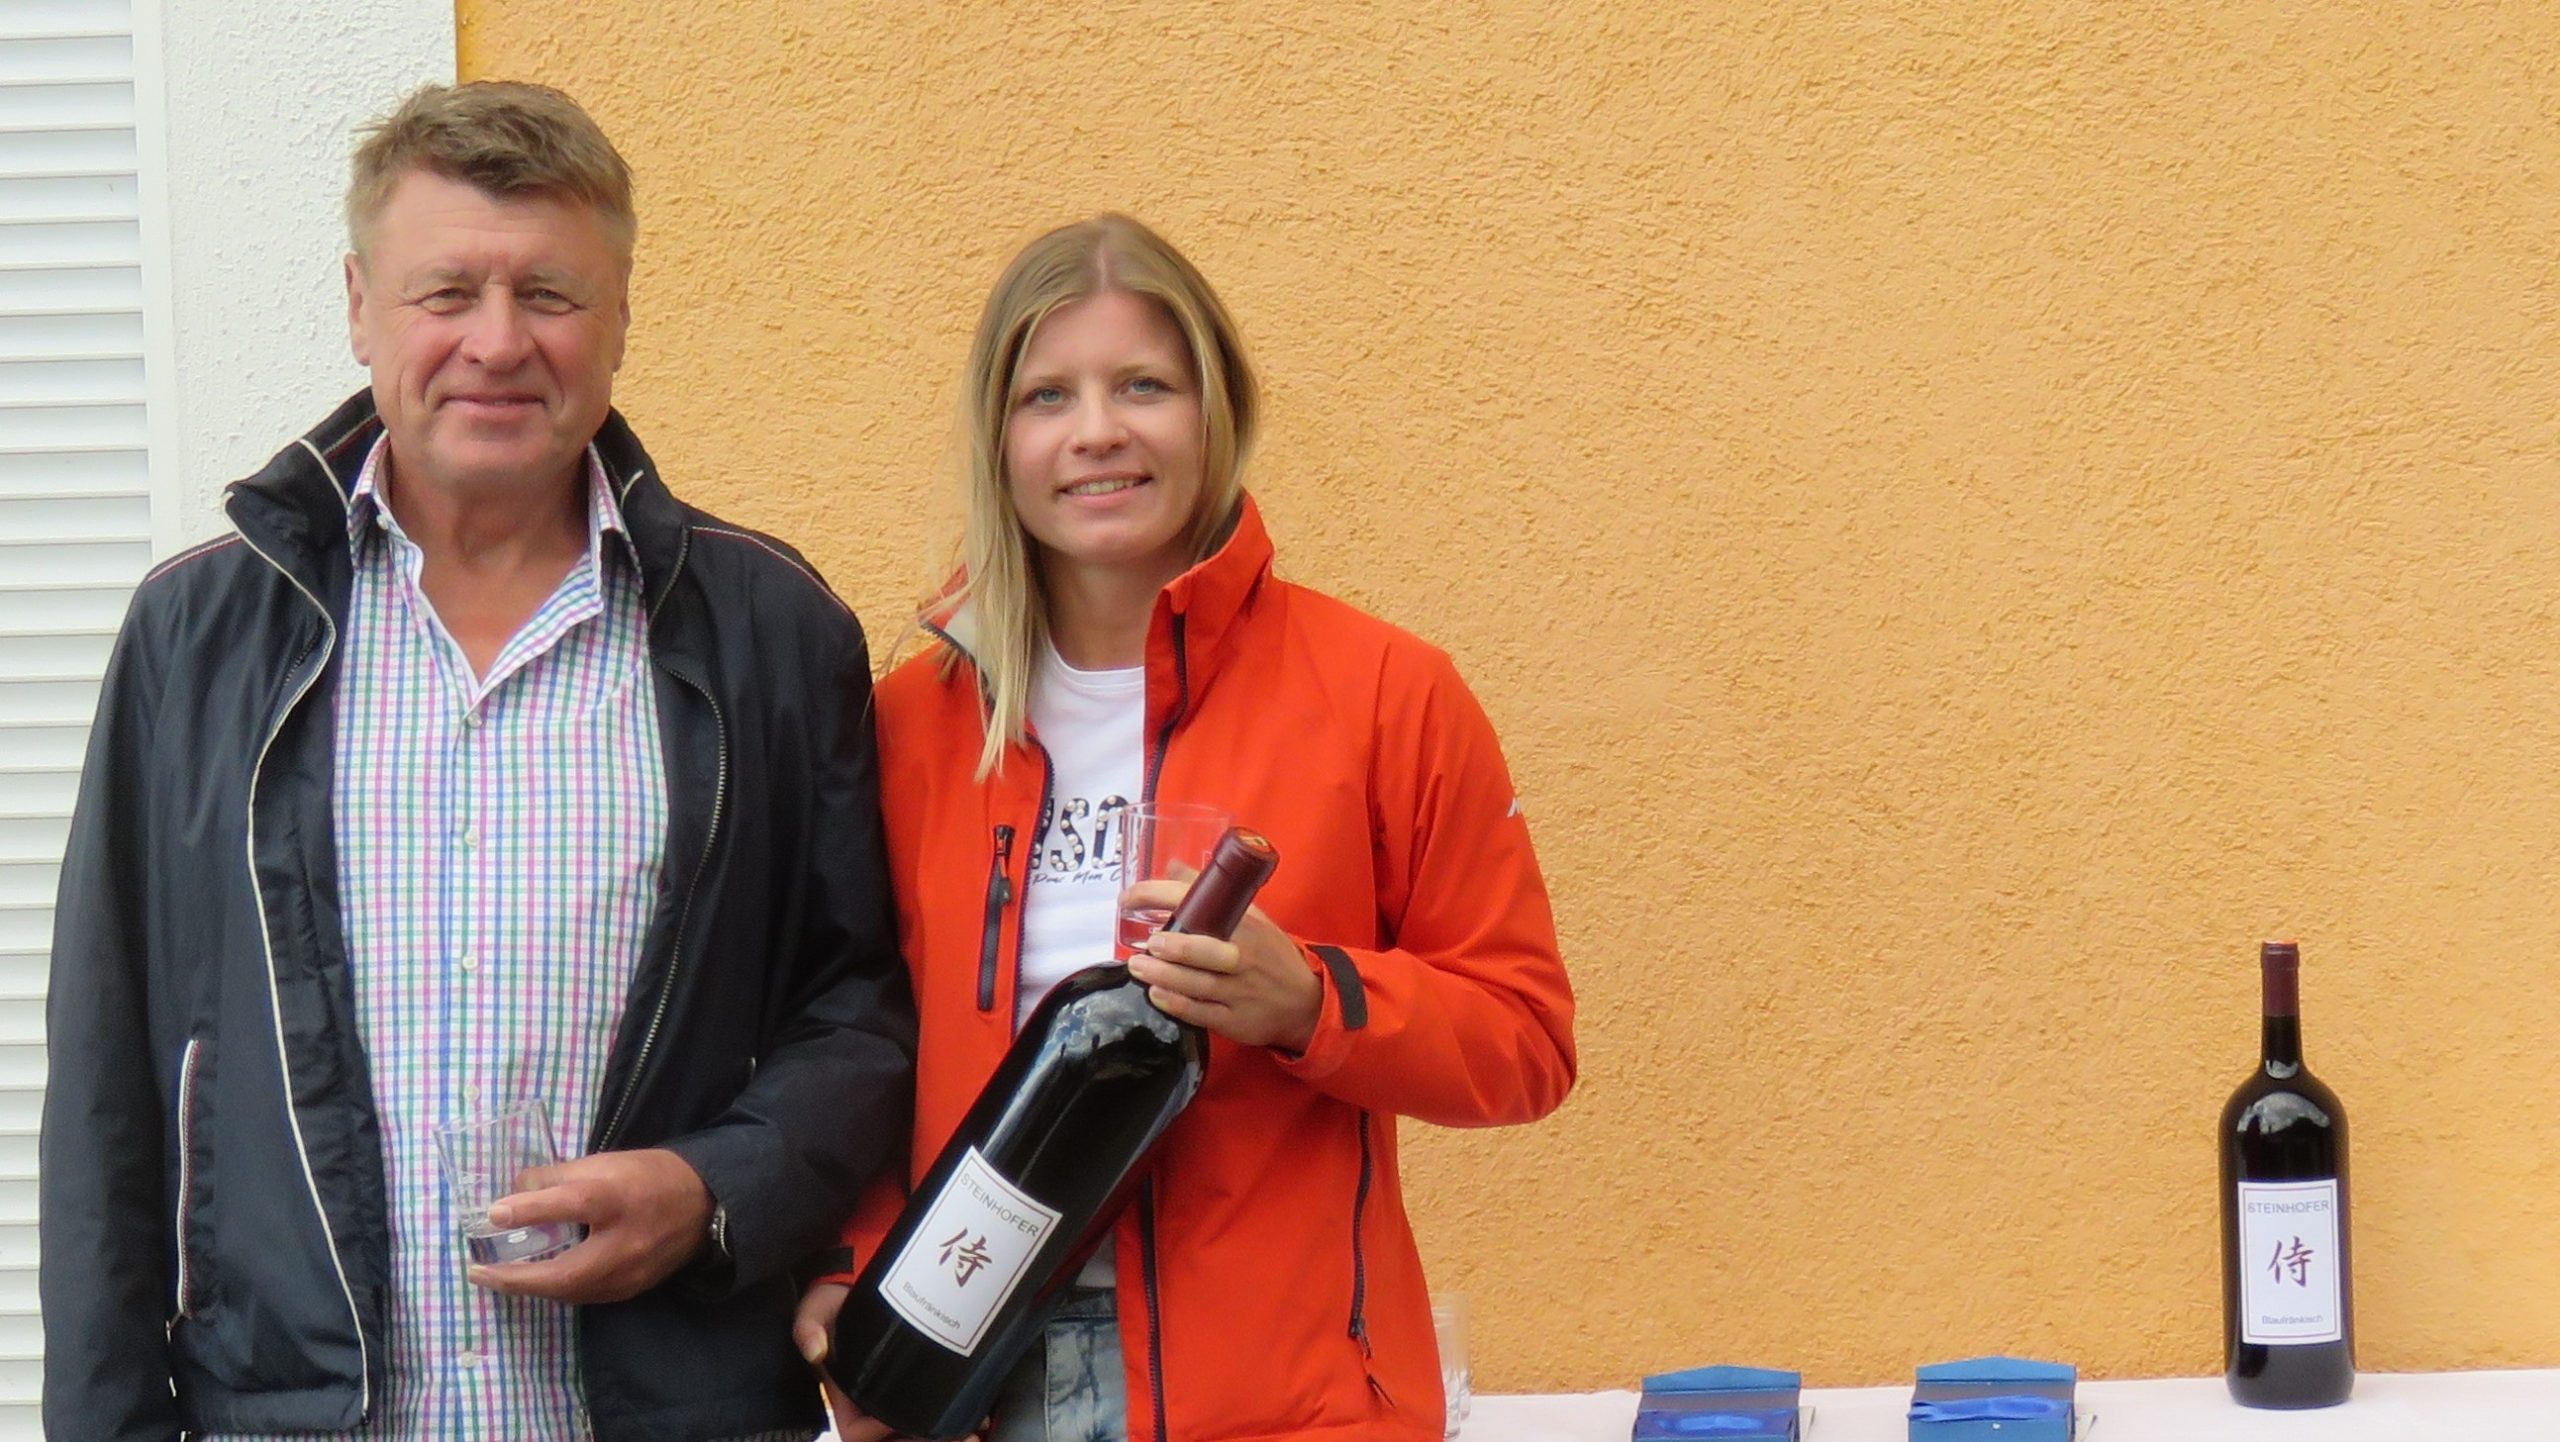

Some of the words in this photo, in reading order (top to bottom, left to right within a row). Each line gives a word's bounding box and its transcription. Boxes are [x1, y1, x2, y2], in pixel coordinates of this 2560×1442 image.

[960, 1172, 1040, 1238] STEINHOFER
[2247, 1200, 2330, 1214] STEINHOFER
[938, 1228, 992, 1287] 侍
[2267, 1235, 2314, 1287] 侍
